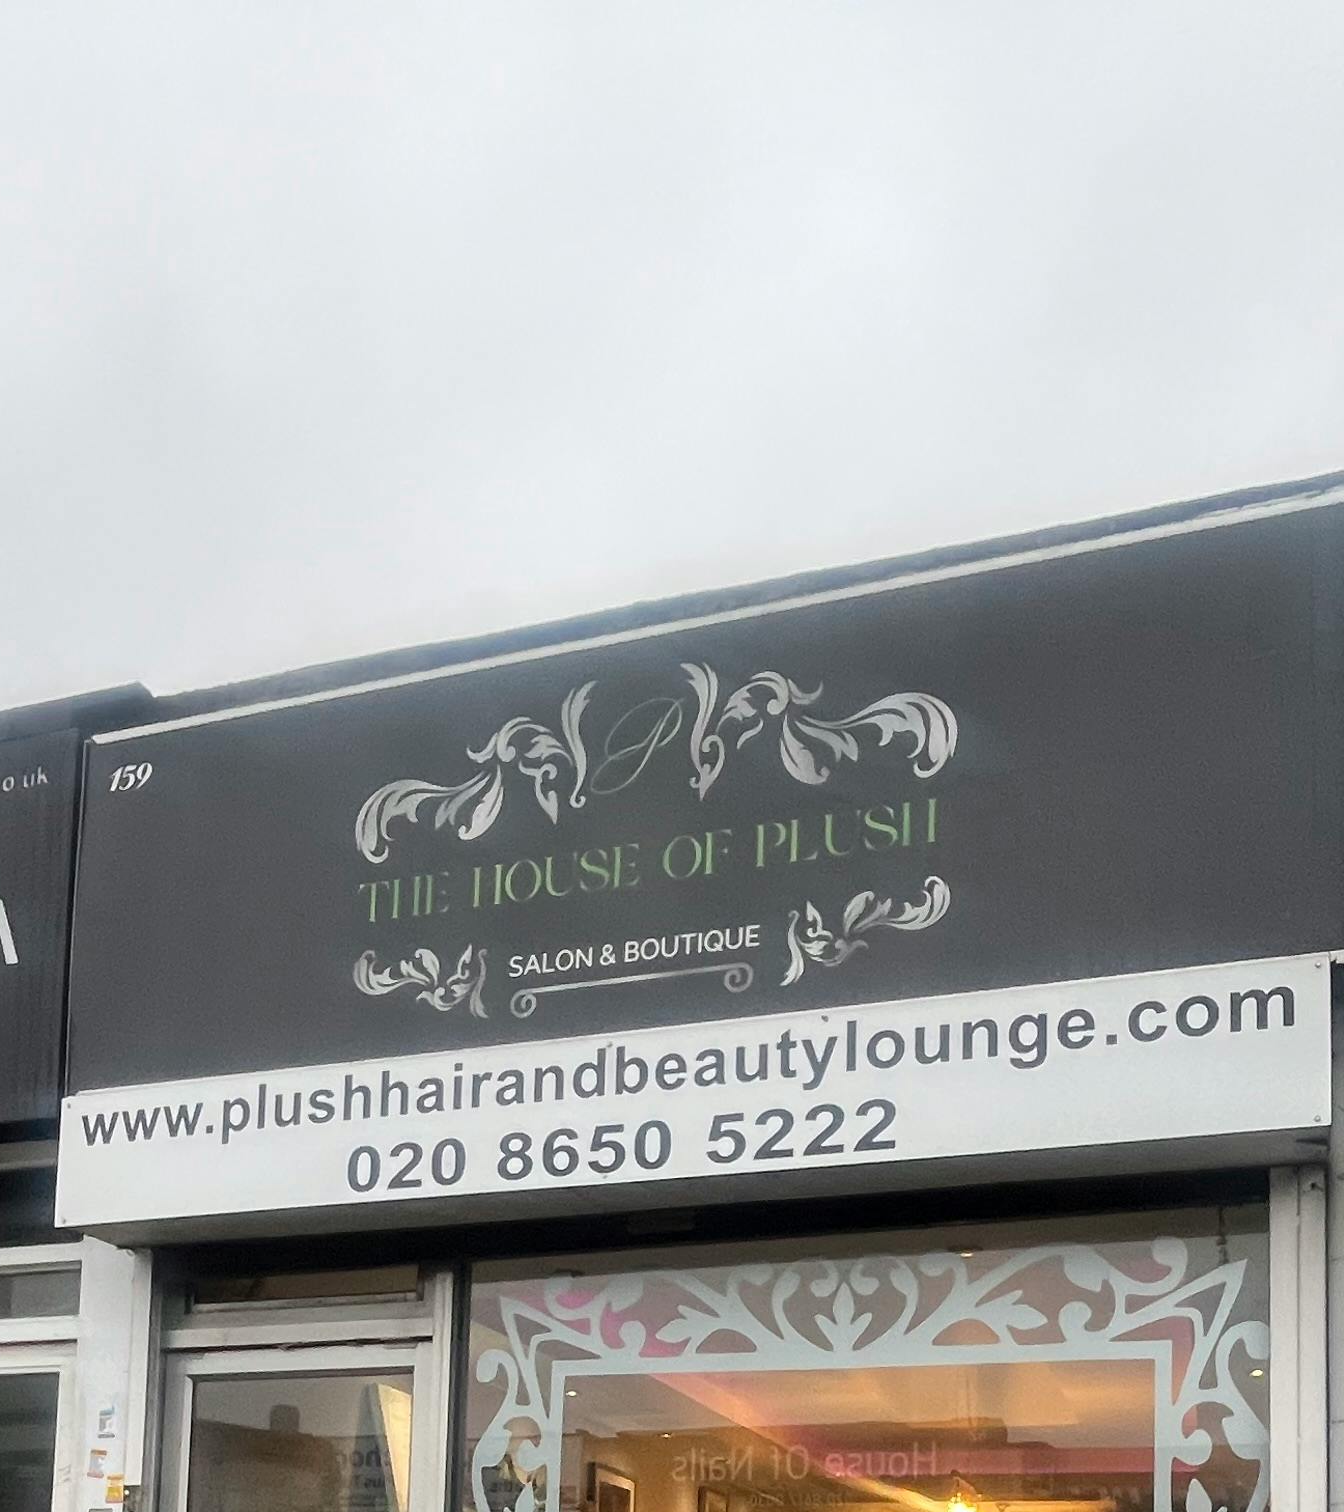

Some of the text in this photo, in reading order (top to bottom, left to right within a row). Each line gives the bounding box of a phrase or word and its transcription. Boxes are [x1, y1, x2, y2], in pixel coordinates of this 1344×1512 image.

[109, 762, 153, 792] 159
[359, 799, 938, 922] THE HOUSE OF PLUSH
[508, 924, 761, 978] SALON & BOUTIQUE
[81, 984, 1295, 1146] www.plushhairandbeautylounge.com
[348, 1098, 897, 1192] 020 8650 5222
